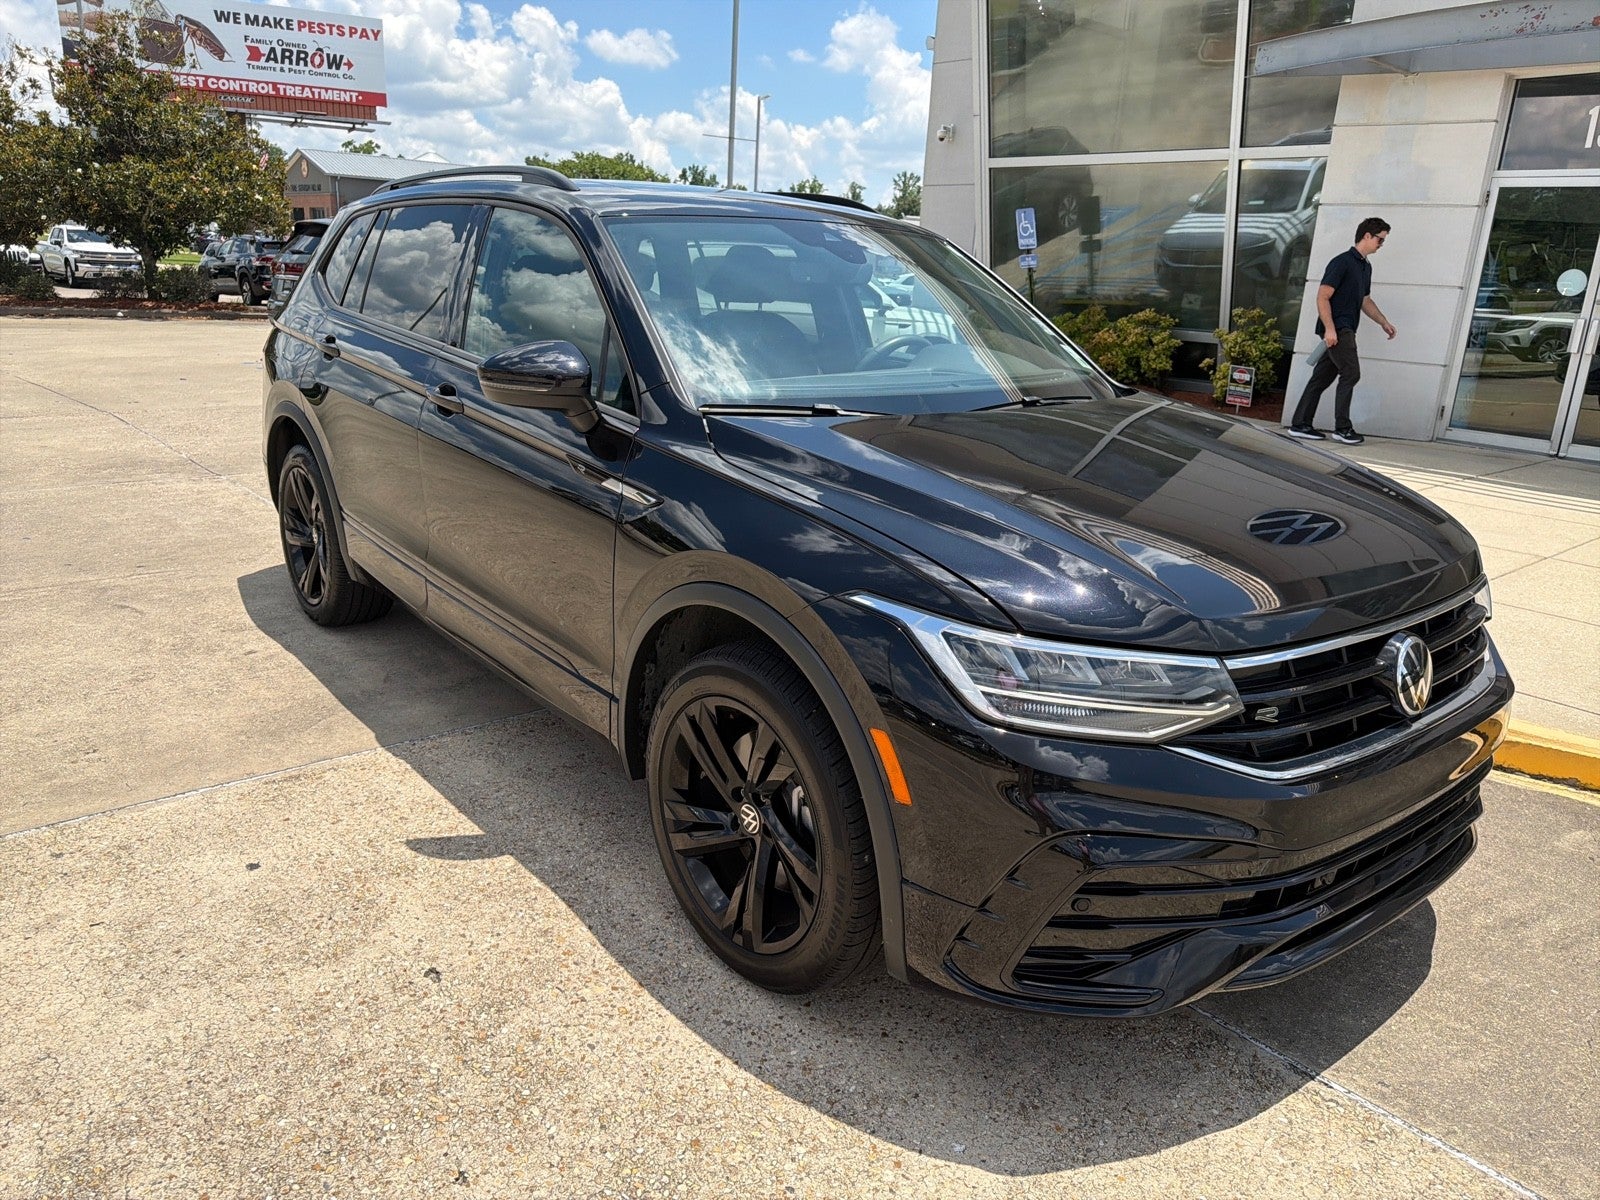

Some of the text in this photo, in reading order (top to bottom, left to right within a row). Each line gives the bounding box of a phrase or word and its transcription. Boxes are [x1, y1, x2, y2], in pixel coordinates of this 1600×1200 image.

[214, 9, 382, 42] WE MAKE PESTS PAY
[243, 34, 308, 50] FAMILY OWNED
[264, 46, 344, 71] ARROW
[246, 63, 278, 73] TERMITE
[287, 67, 306, 76] PEST
[308, 69, 341, 79] CONTROL
[174, 75, 205, 88] PEST
[207, 78, 275, 95] CONTROL
[1584, 105, 1600, 149] 1
